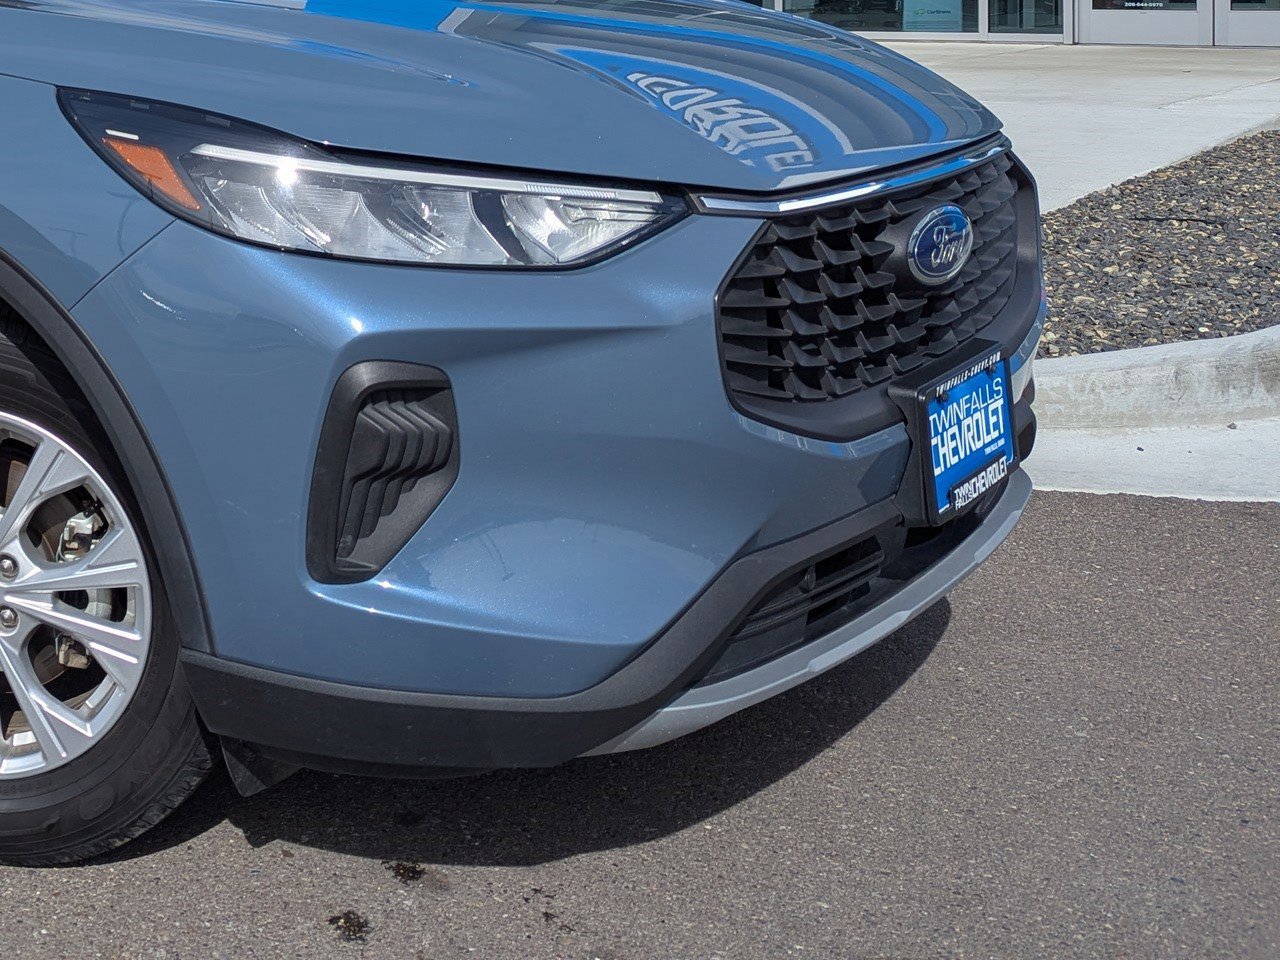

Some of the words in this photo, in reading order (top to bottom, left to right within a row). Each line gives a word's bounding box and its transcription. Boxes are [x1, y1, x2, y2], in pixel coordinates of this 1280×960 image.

[929, 377, 1004, 437] TWINFALLS
[931, 398, 1004, 477] CHEVROLET
[972, 455, 1008, 499] CHEVROLET
